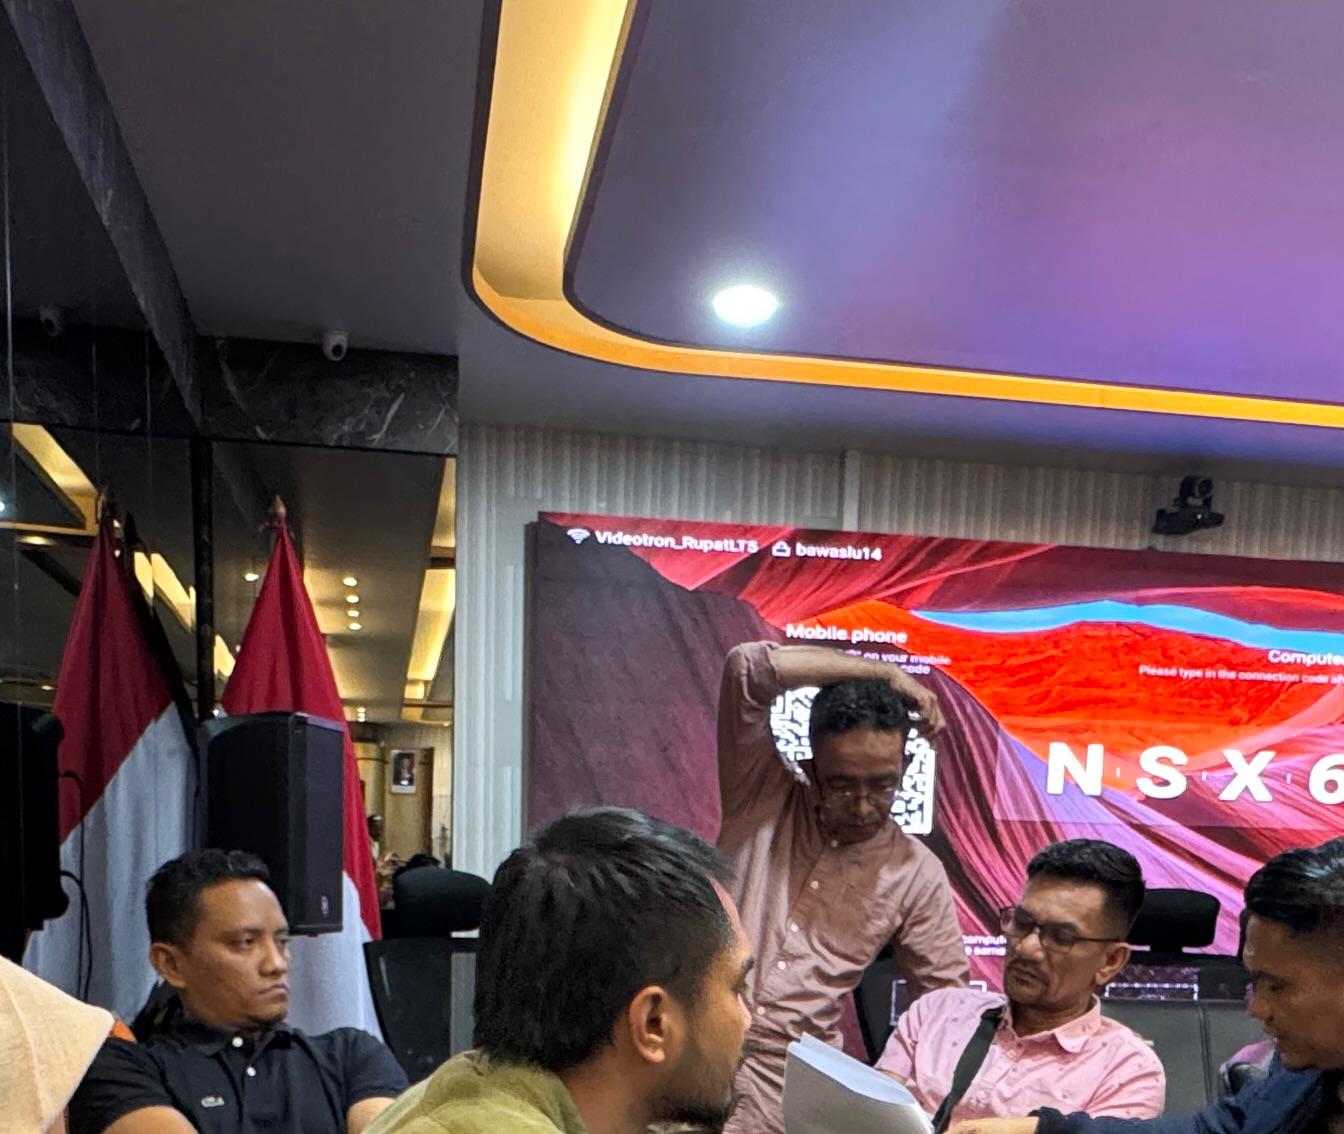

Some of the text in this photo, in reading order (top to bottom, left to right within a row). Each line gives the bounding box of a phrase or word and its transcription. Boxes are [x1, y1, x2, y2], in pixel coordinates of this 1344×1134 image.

[786, 624, 908, 643] Mobile phone
[882, 653, 908, 663] your
[910, 654, 952, 666] mobile
[1139, 664, 1177, 677] Please
[1179, 667, 1203, 680] type
[1206, 669, 1216, 679] in
[1218, 669, 1237, 680] the
[1238, 671, 1299, 683] connection
[1302, 674, 1328, 684] code
